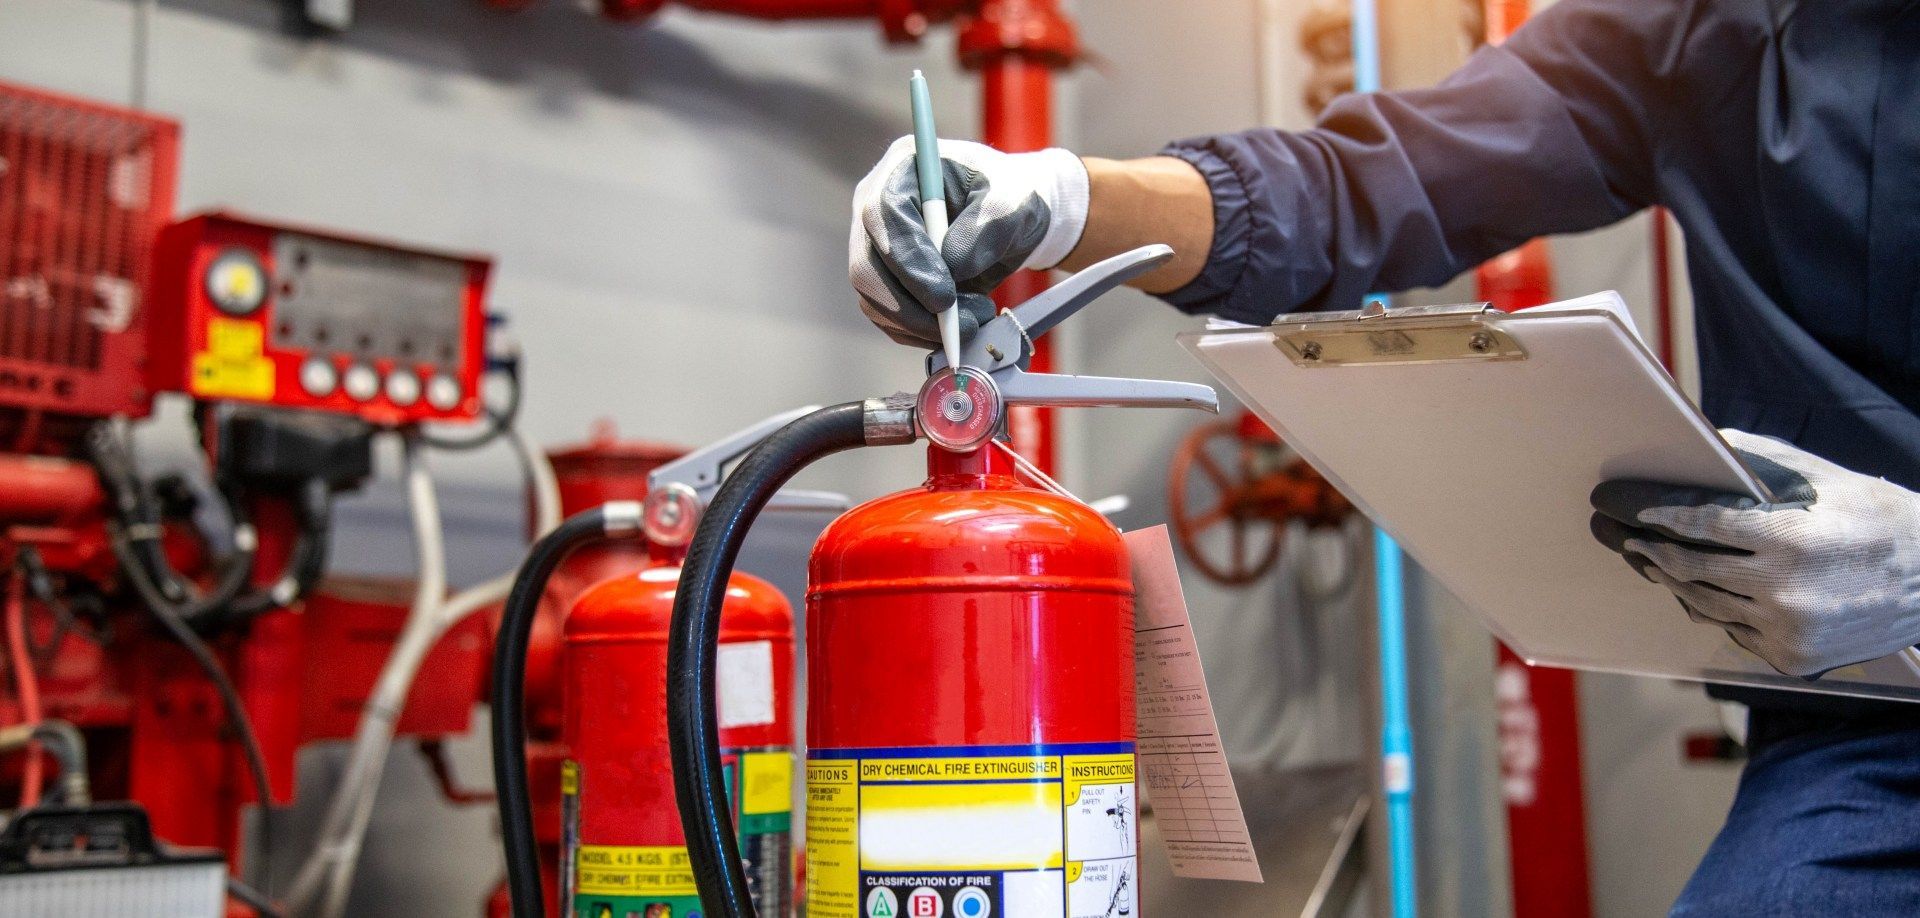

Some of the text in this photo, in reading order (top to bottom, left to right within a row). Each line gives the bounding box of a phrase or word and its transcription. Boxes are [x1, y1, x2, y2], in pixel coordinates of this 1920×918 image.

[863, 761, 1058, 776] DRY CHEMICAL FIRE EXTINGUISHER
[1071, 764, 1134, 777] INSTRUCTIONS
[1072, 867, 1077, 875] 2
[867, 876, 992, 886] CLASSIFICATION OF FIRE
[918, 897, 933, 915] B
